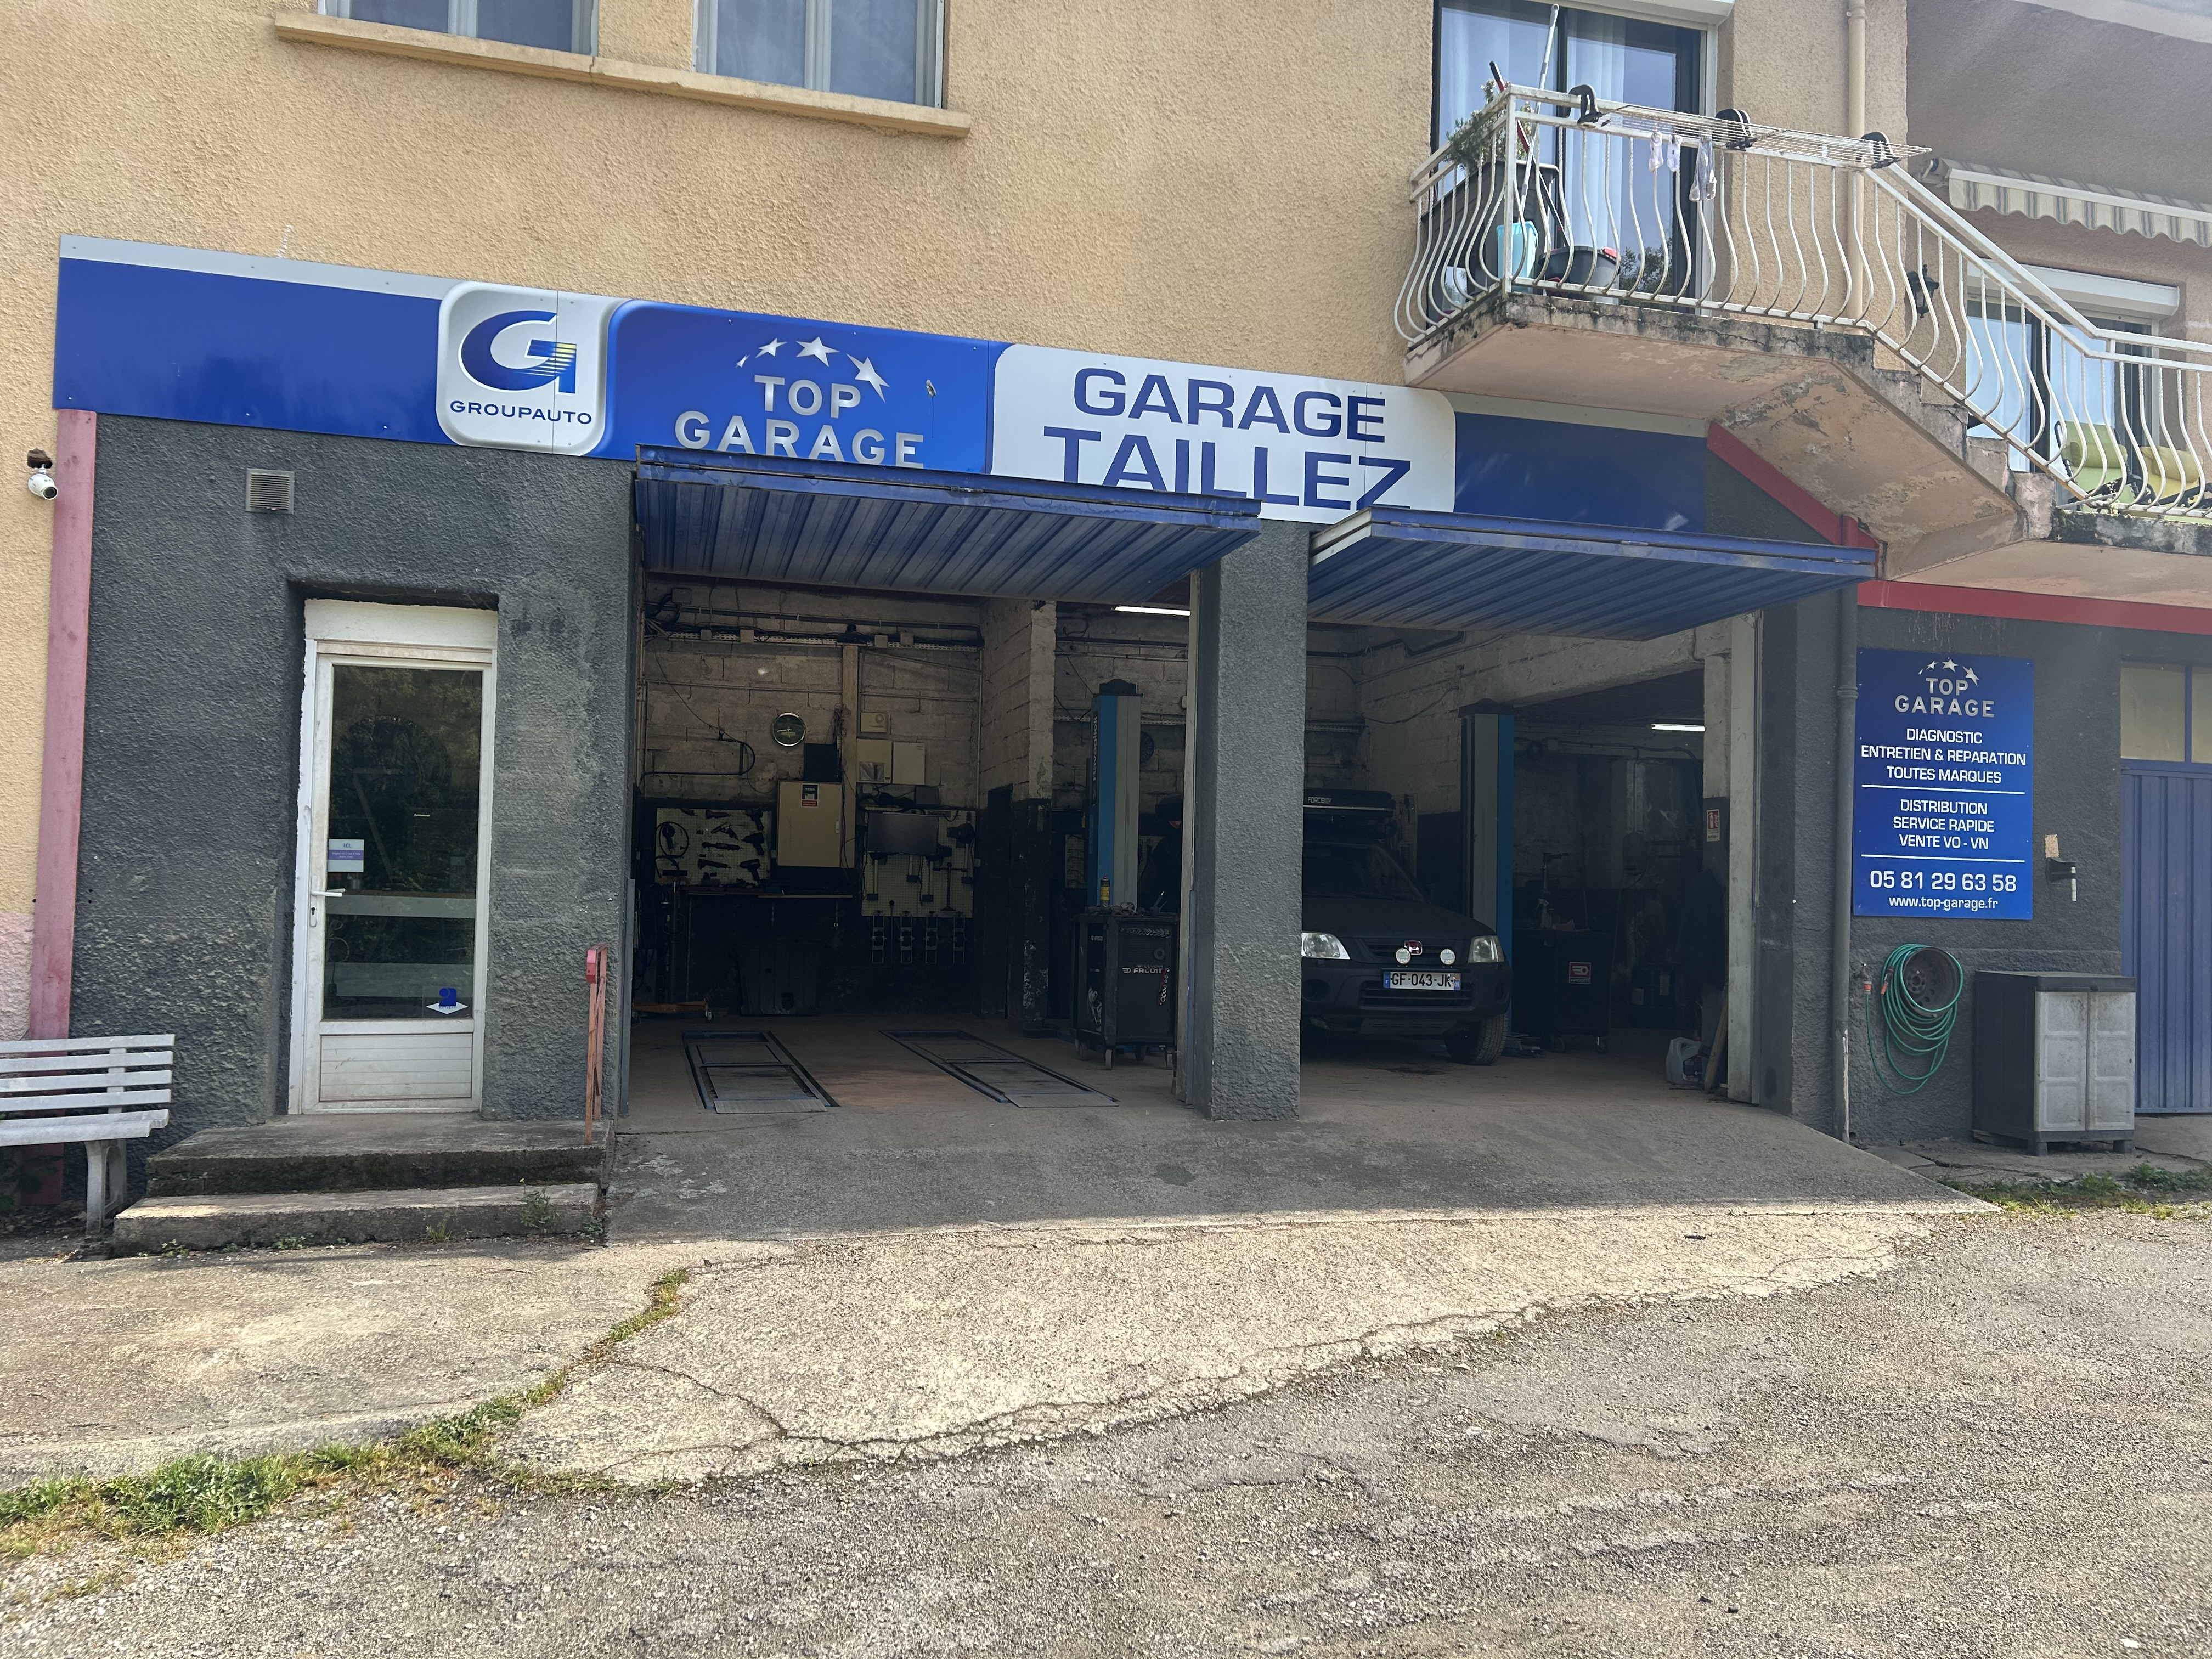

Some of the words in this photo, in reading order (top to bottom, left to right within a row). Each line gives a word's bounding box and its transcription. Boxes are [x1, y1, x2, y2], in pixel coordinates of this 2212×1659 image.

[754, 374, 861, 419] TOP
[1074, 368, 1386, 443] GARAGE
[450, 400, 592, 425] GROUPAUTO
[675, 410, 924, 469] GARAGE
[1043, 426, 1411, 511] TAILLEZ
[1926, 678, 1968, 696] TOP
[1895, 695, 1994, 718] GARAGE
[1906, 728, 1982, 744] DIAGNOSTIC
[1861, 745, 1931, 761] ENTRETIEN
[1934, 749, 1944, 761] &
[1947, 750, 2026, 765] REPARATION
[1886, 766, 1935, 780] TOUTES
[1939, 769, 2001, 783] MARQUES
[1900, 799, 1988, 815] DISTRIBUTION
[1893, 816, 1945, 831] SERVICE
[1949, 819, 1994, 832] RAPIDE
[1899, 834, 1940, 848] VENTE
[1944, 836, 1961, 849] VO
[1970, 837, 1989, 849] VN
[1870, 870, 1895, 889] 05
[1901, 871, 1923, 889] 81
[1932, 872, 1956, 890] 29
[1962, 873, 1987, 891] 63
[1993, 874, 2017, 893] 58
[1889, 896, 1999, 912] www.top-garage.fr
